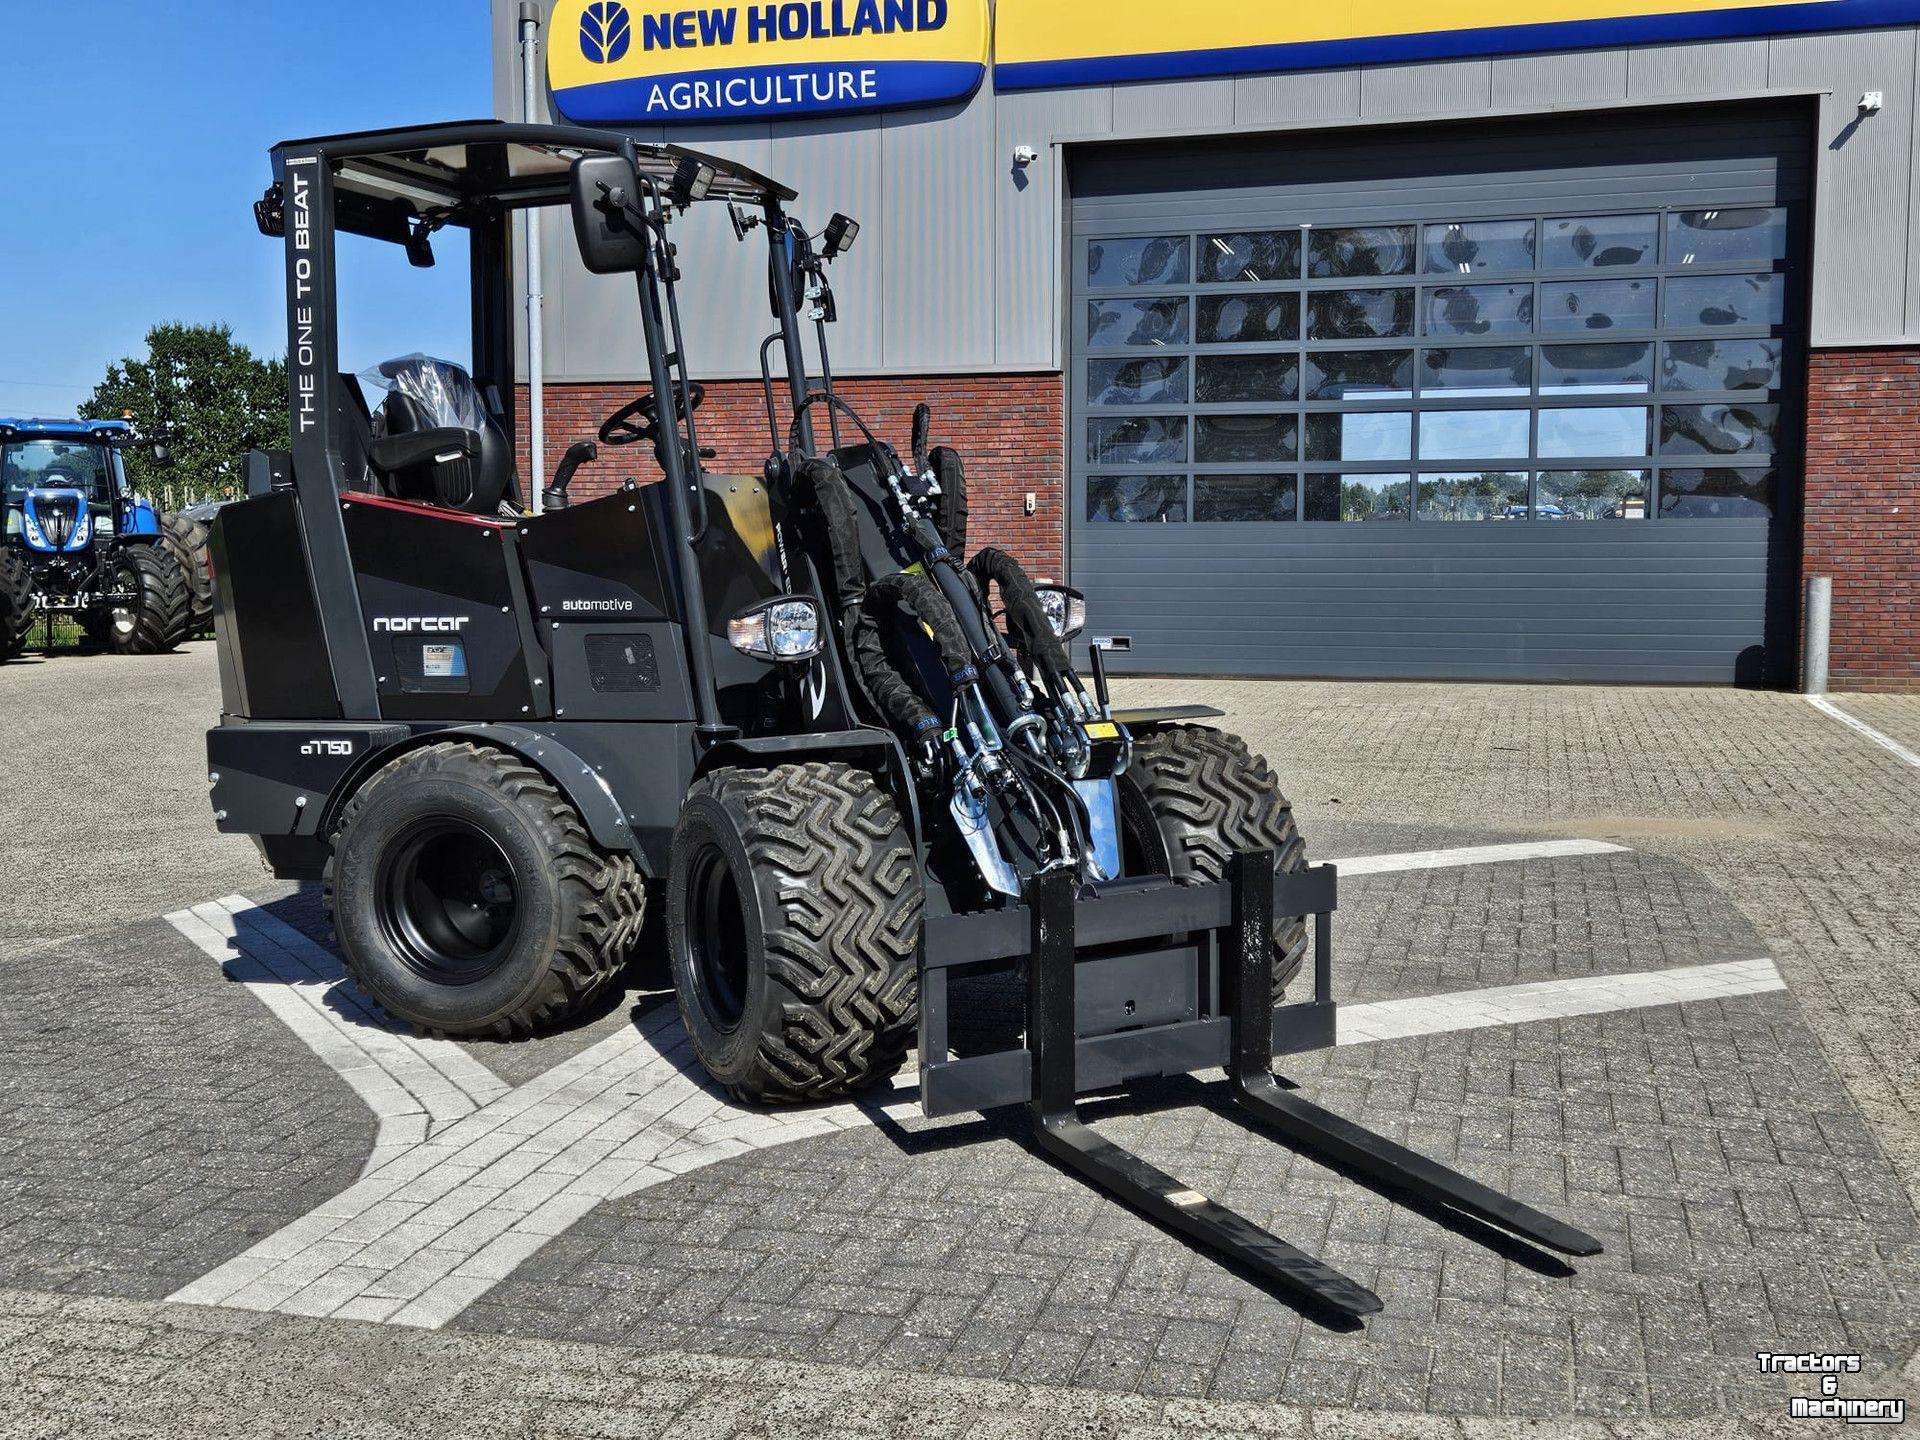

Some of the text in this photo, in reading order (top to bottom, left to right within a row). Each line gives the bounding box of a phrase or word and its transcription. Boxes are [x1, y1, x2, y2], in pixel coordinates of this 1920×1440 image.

[643, 0, 947, 50] NEW HOLLAND
[646, 69, 877, 112] AGRICULTURE
[293, 172, 310, 250] BEAT
[296, 258, 311, 300] TO
[297, 306, 313, 366] ONE
[299, 373, 315, 433] THE
[373, 616, 470, 632] norcar
[562, 598, 633, 611] automotive
